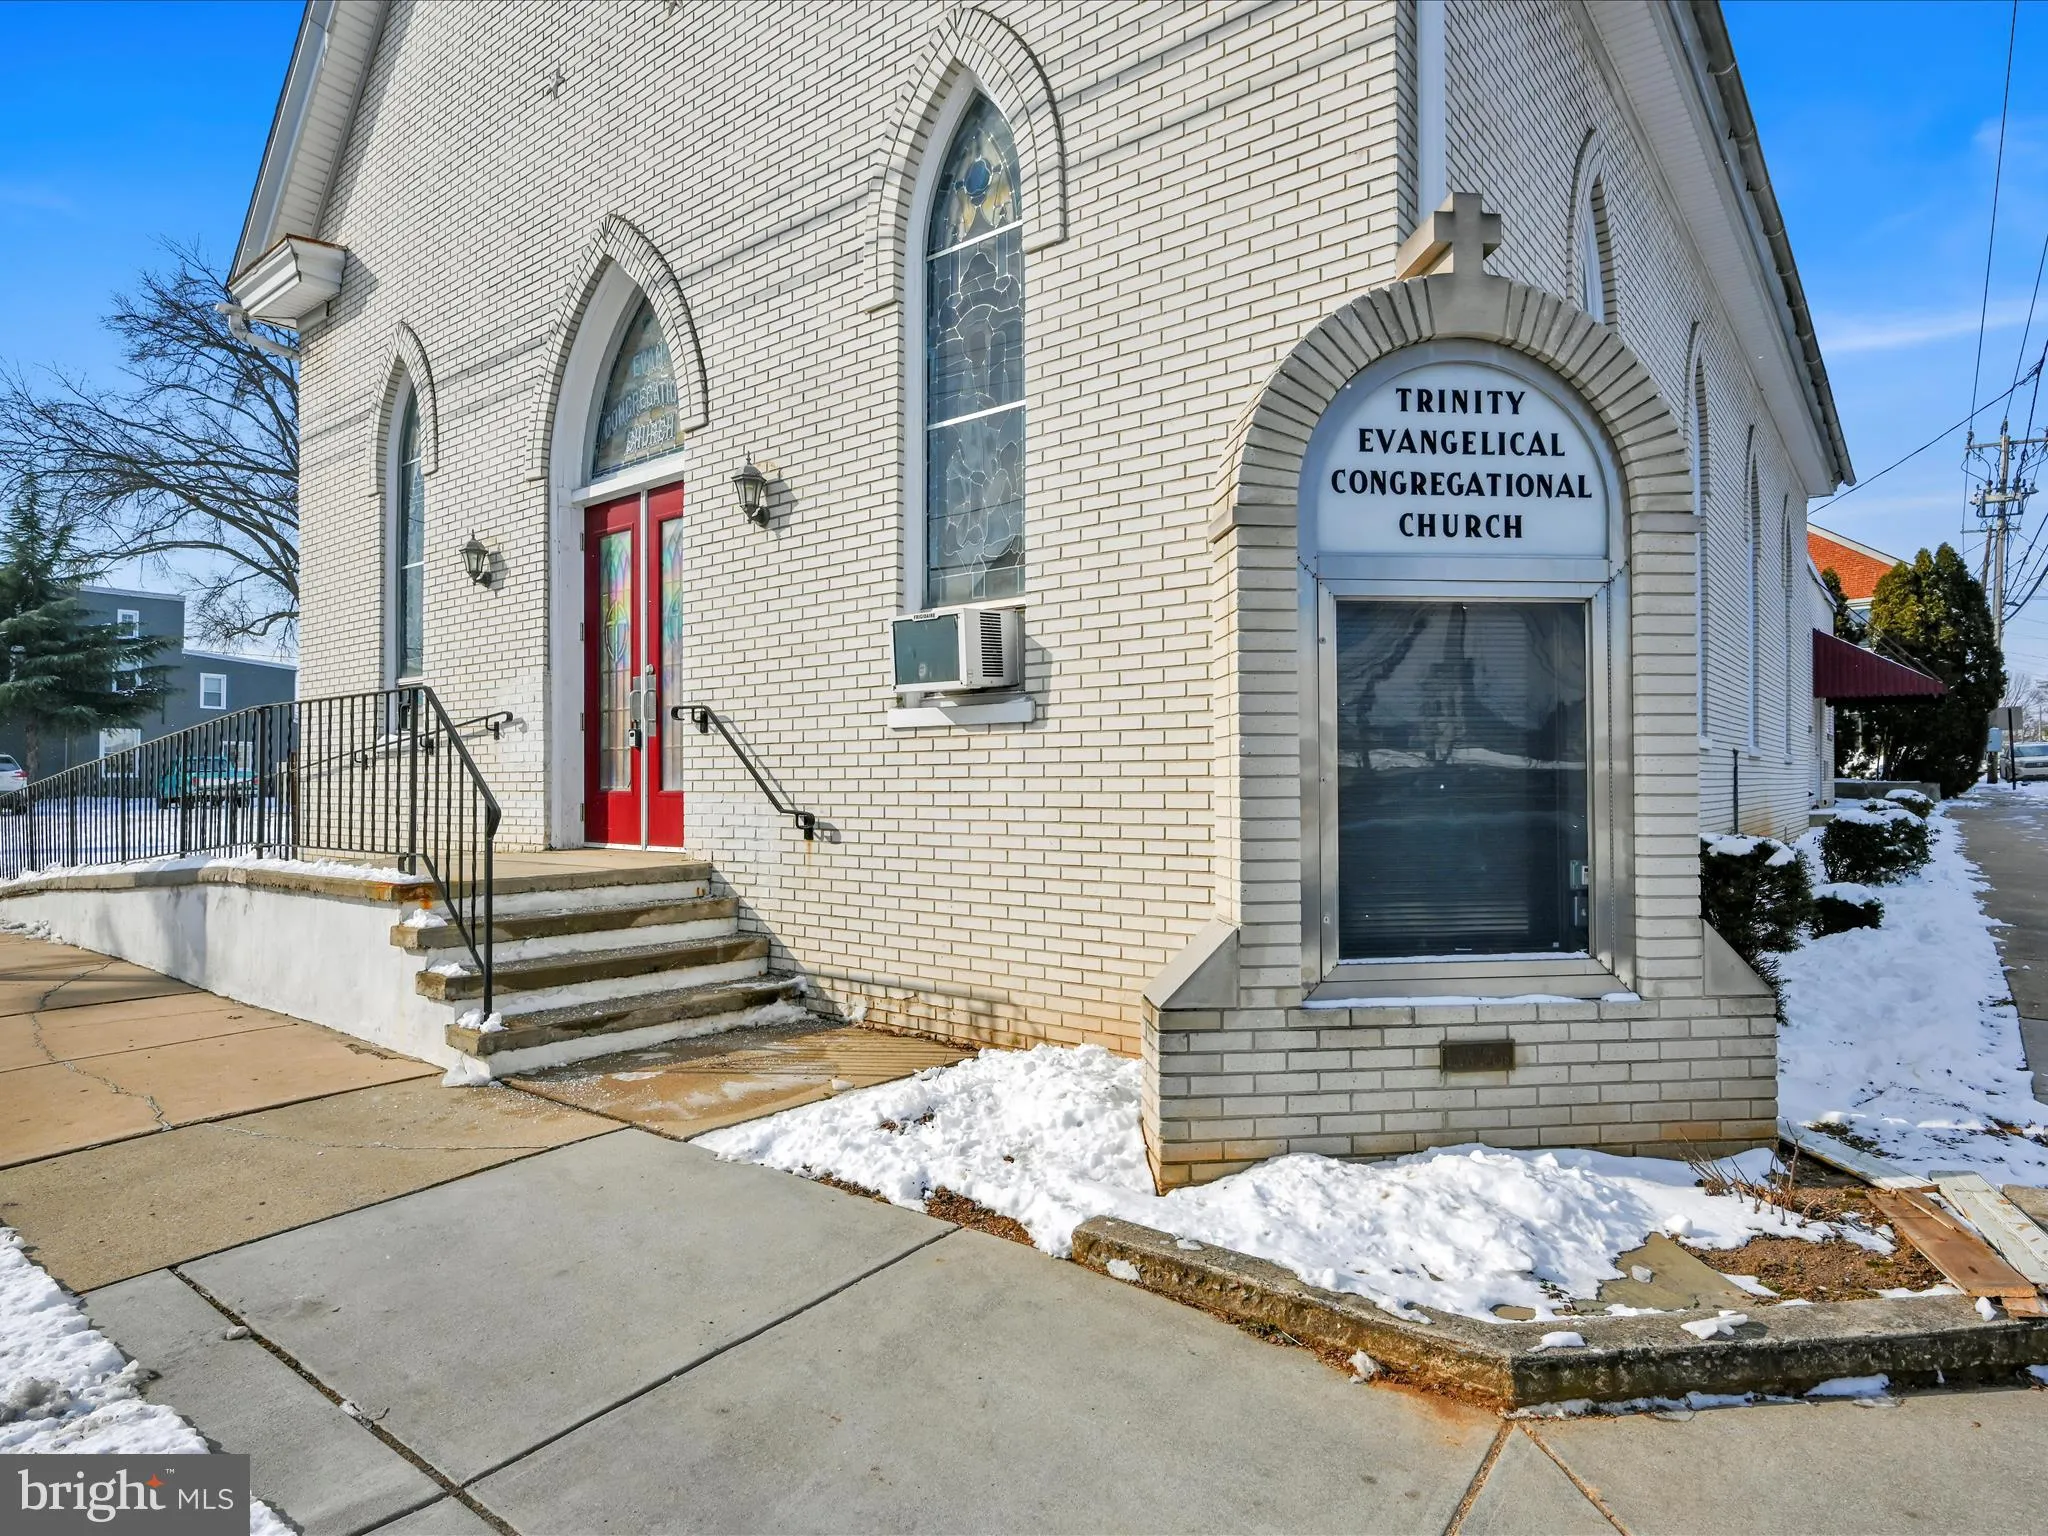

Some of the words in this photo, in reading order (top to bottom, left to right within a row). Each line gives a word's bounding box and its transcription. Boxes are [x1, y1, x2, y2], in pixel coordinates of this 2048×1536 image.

[1396, 388, 1525, 415] TRINITY
[1358, 428, 1565, 457] EVANGELICAL
[1331, 469, 1592, 499] CONGREGATIONAL
[1399, 512, 1523, 539] CHURCH
